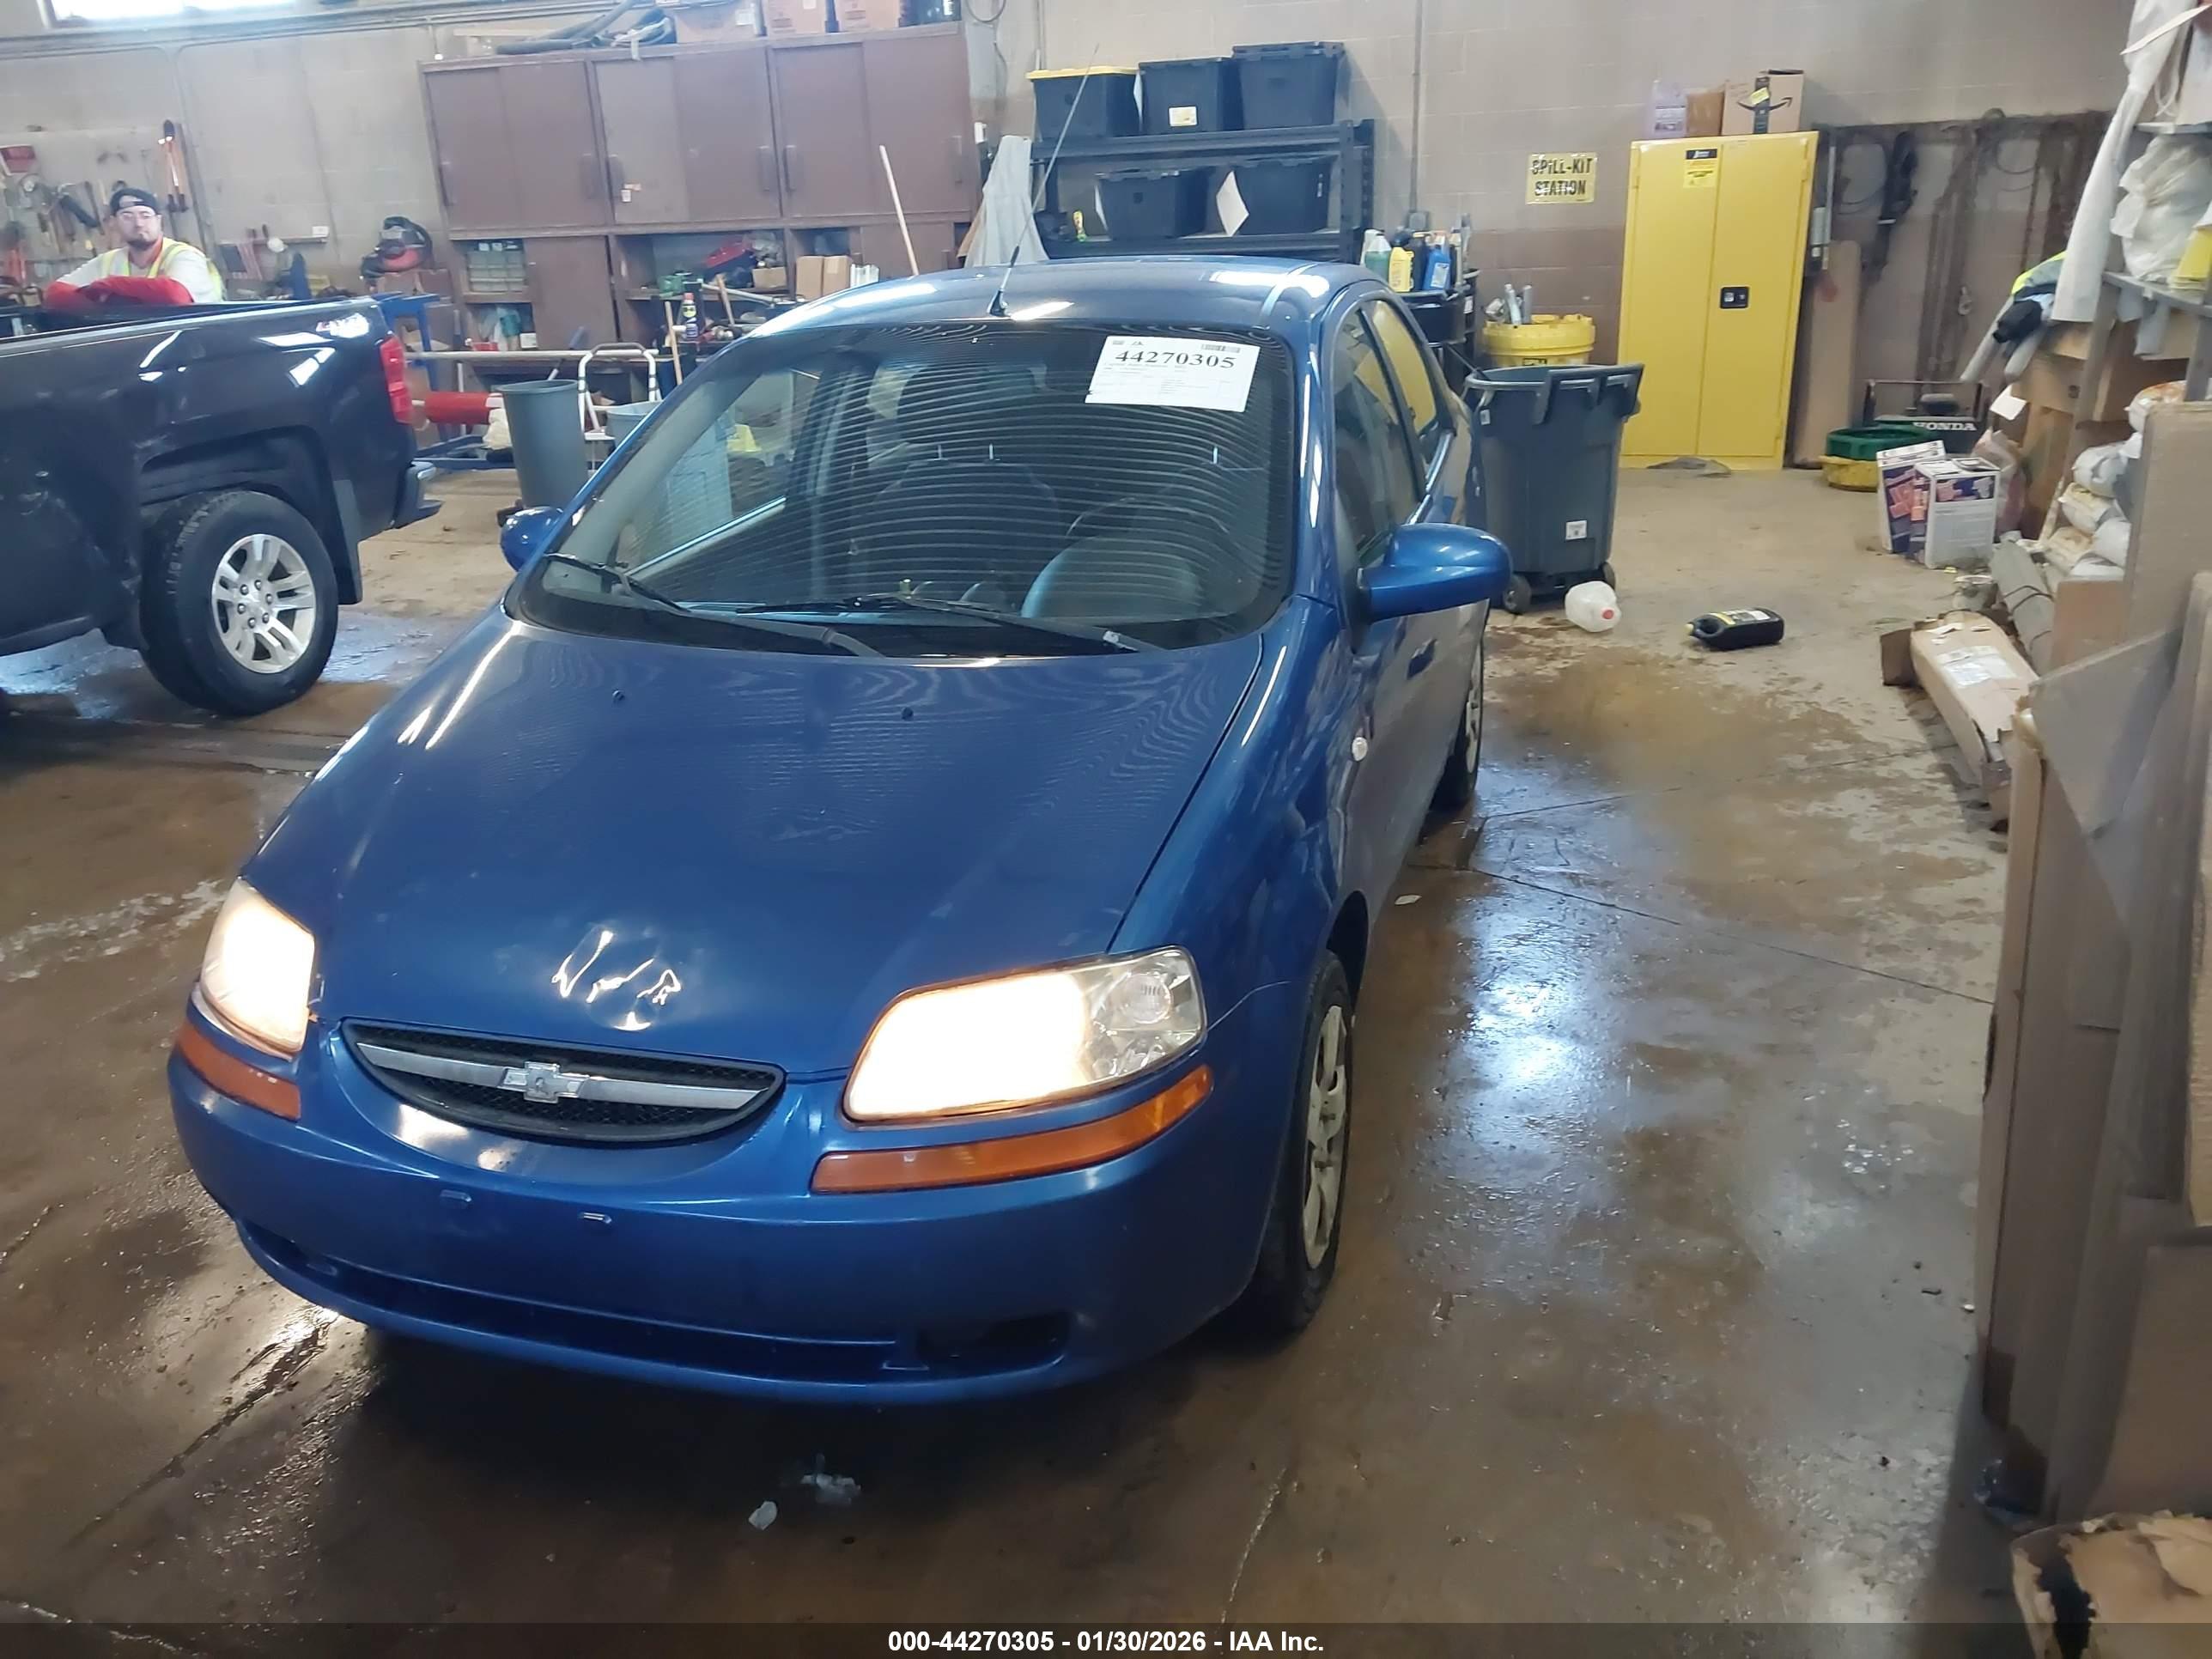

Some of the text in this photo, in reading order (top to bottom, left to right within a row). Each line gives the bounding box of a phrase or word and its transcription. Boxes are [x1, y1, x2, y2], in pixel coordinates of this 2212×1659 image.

[1531, 158, 1593, 175] SPILL-KIT
[1534, 179, 1587, 197] STATION
[1115, 350, 1237, 368] 44270305
